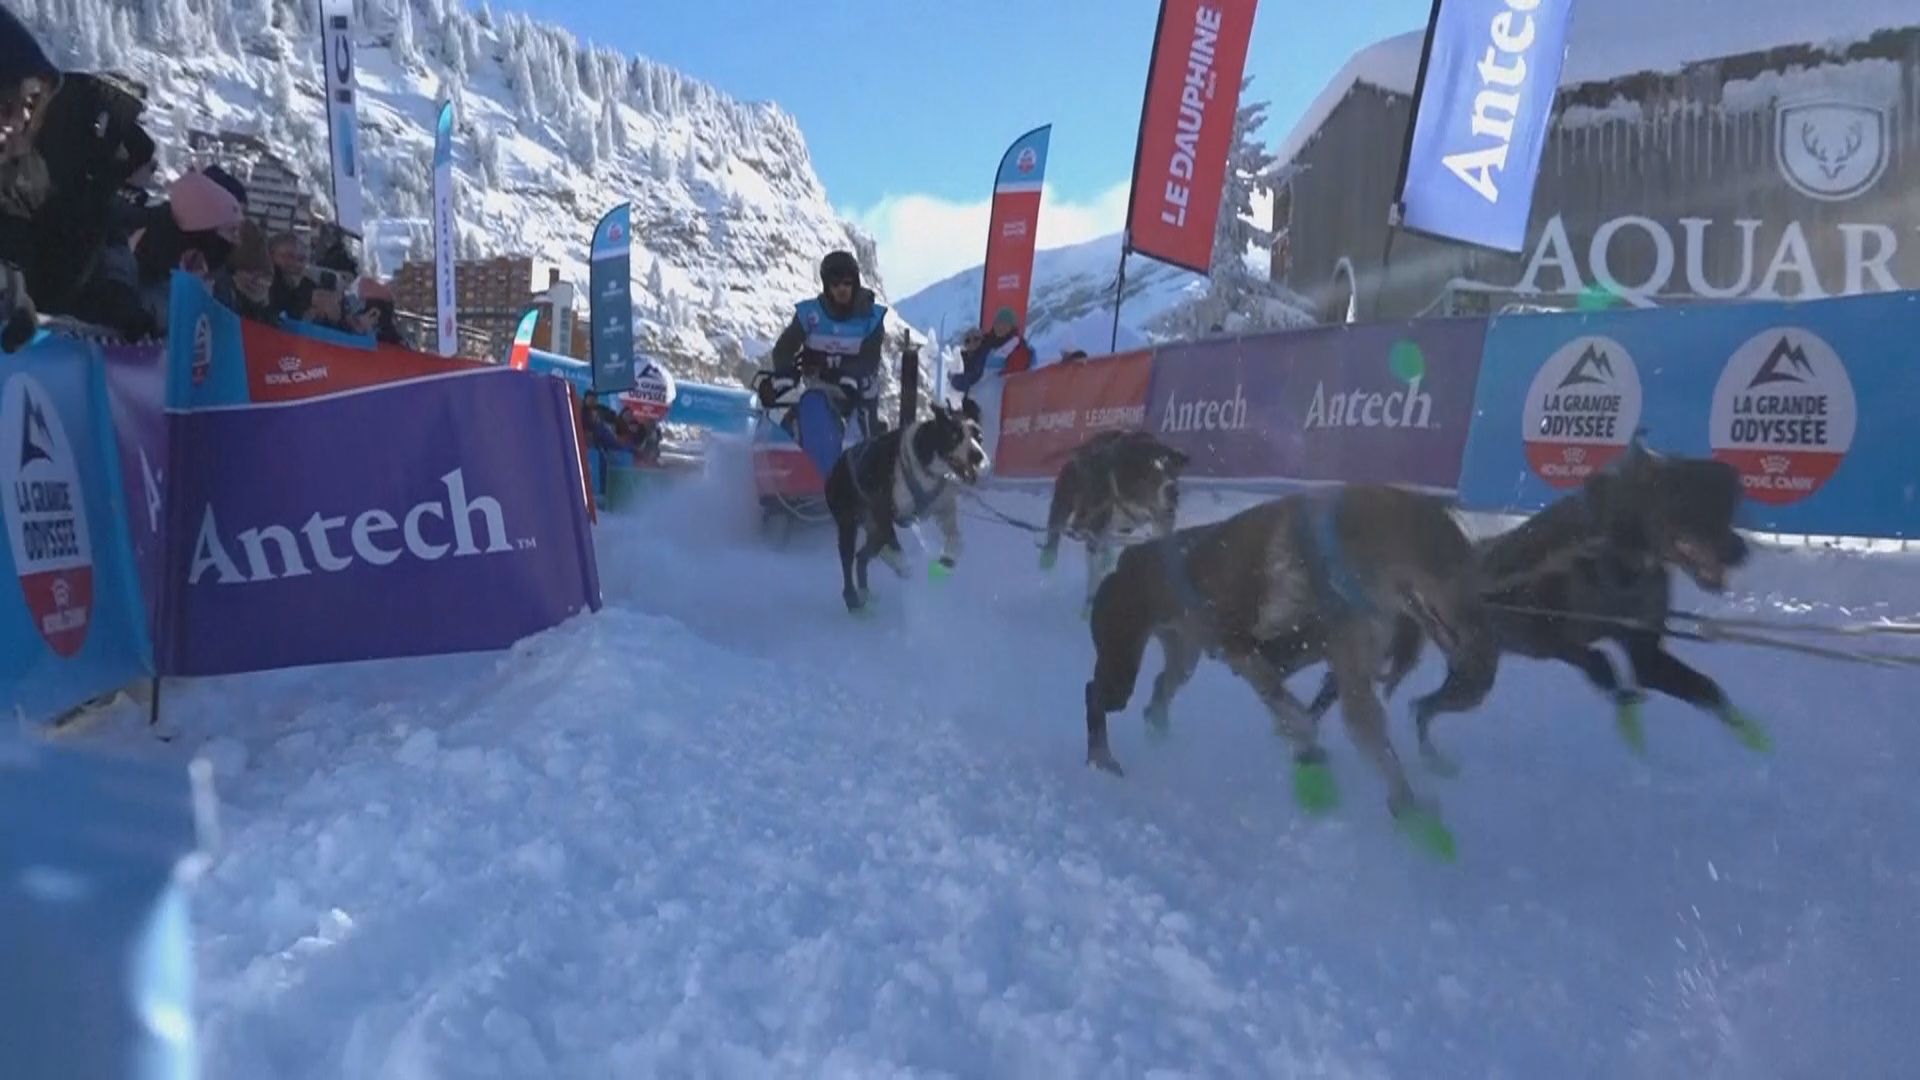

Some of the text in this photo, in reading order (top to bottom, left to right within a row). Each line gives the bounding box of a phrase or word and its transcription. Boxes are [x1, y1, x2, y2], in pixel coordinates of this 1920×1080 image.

[1161, 181, 1190, 227] LE
[1516, 211, 1920, 308] AQUAR
[1161, 384, 1248, 432] Antech
[1305, 375, 1432, 431] Antech
[1543, 394, 1621, 412] LA GRANDE
[1733, 394, 1828, 415] LA GRANDE
[188, 467, 514, 585] Antech
